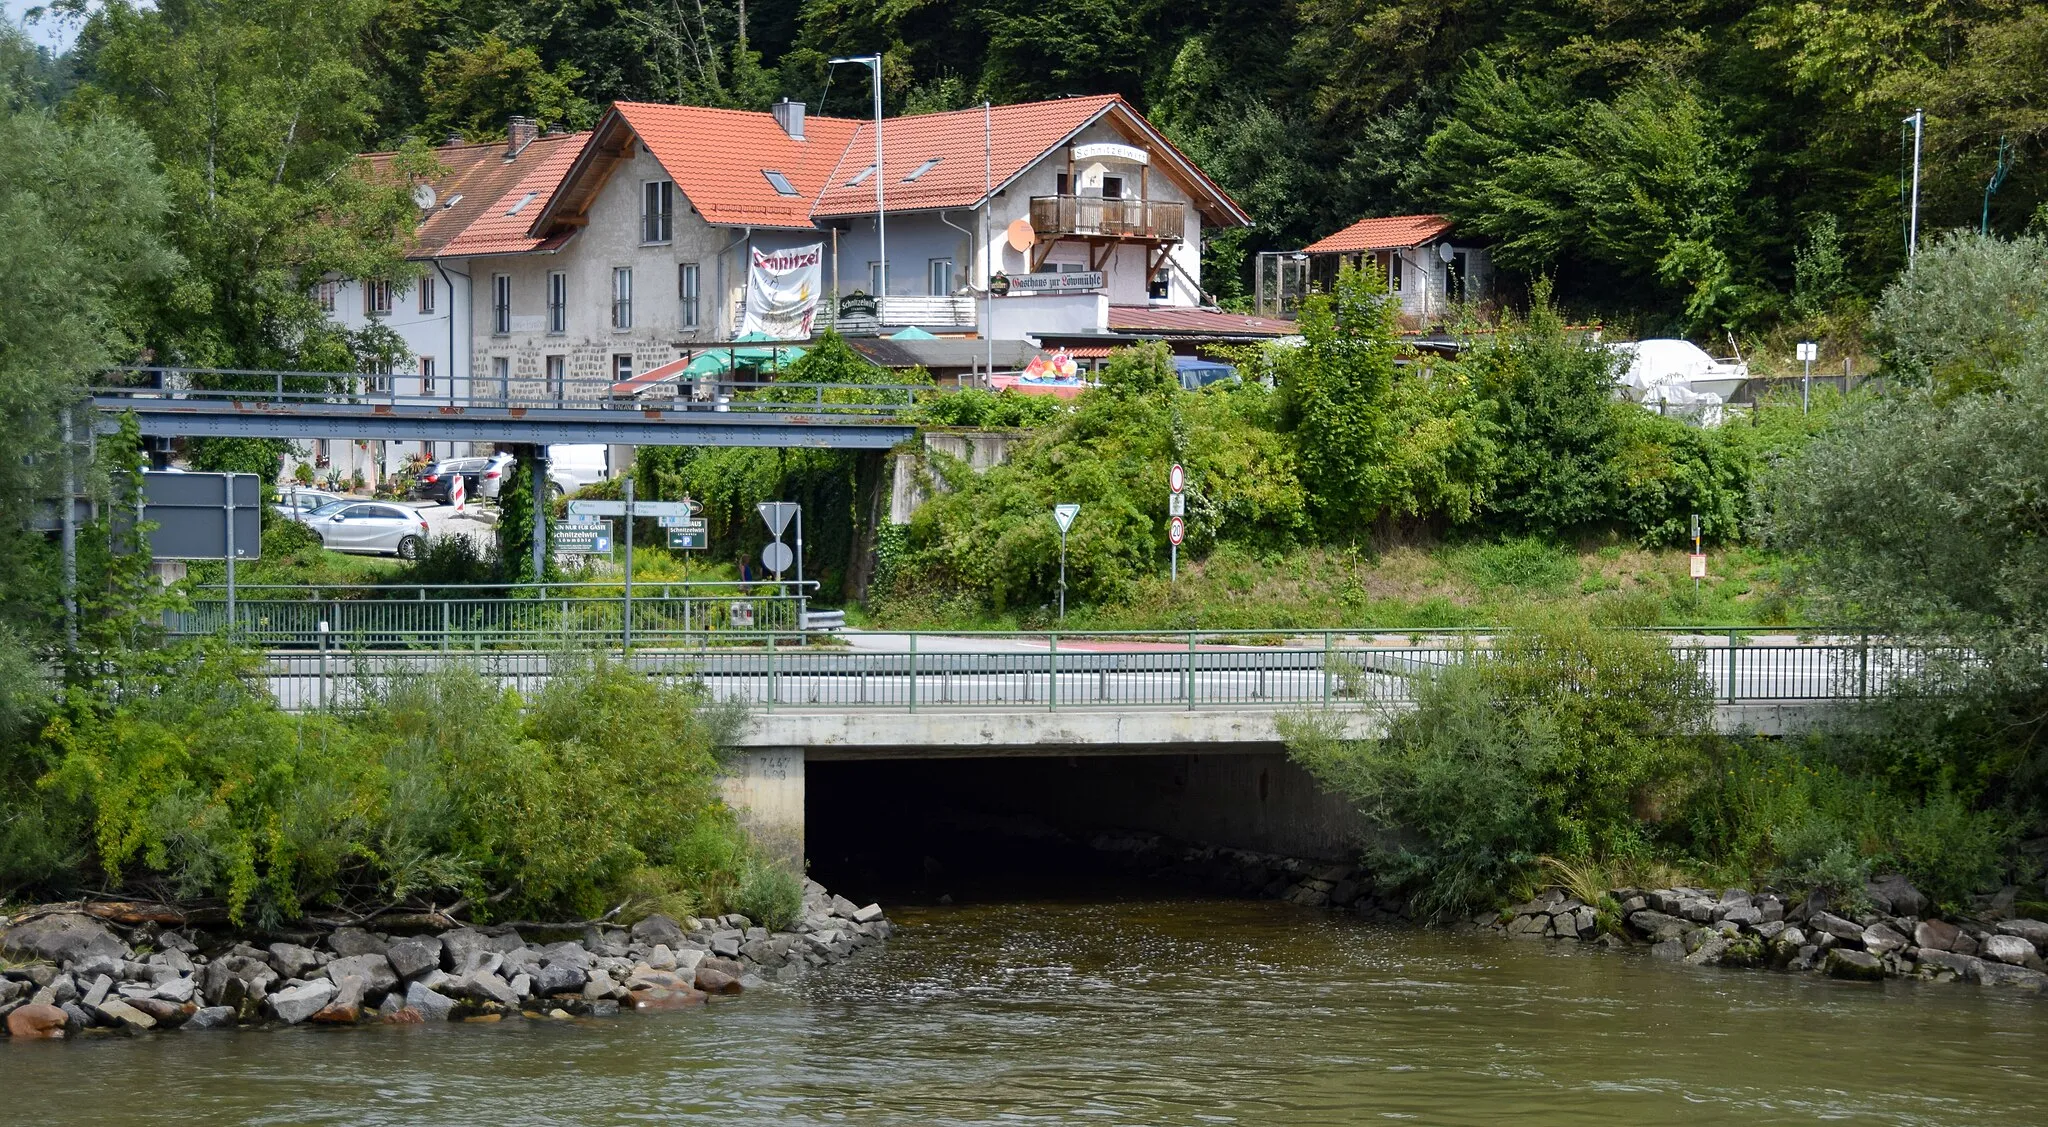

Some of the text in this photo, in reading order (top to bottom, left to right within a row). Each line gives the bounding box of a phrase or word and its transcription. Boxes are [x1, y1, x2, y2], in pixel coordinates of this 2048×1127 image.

[1076, 146, 1146, 161] Schnitzelwirt
[1012, 277, 1047, 289] Gasthaus
[1049, 278, 1061, 289] zur
[842, 299, 875, 310] Schnitzelwirt
[1173, 525, 1181, 537] 20
